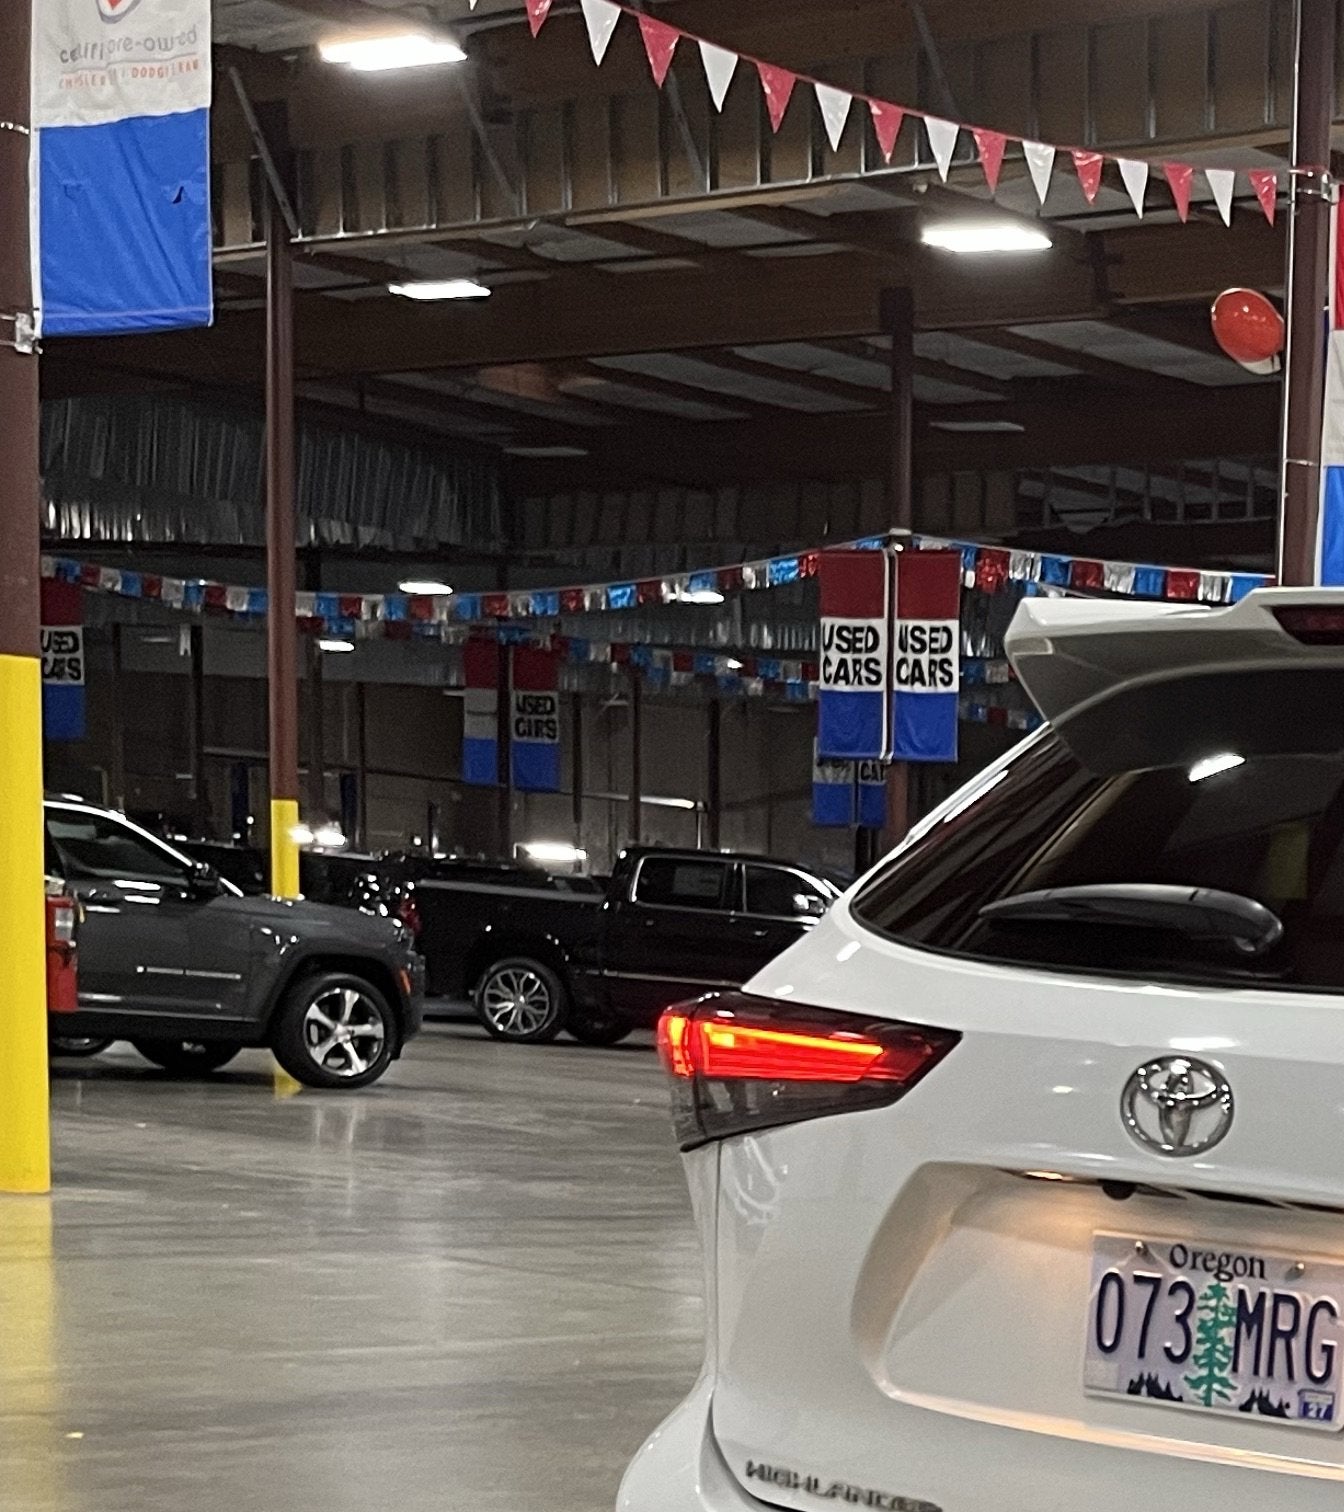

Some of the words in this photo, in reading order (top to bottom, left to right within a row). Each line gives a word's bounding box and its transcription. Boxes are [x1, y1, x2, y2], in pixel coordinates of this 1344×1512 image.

[823, 624, 880, 654] USED
[899, 624, 953, 654] USED
[823, 655, 882, 686] CARS
[896, 657, 953, 687] CARS
[1169, 1244, 1268, 1282] Oregon
[1096, 1269, 1196, 1364] 073
[1231, 1285, 1340, 1385] MRG
